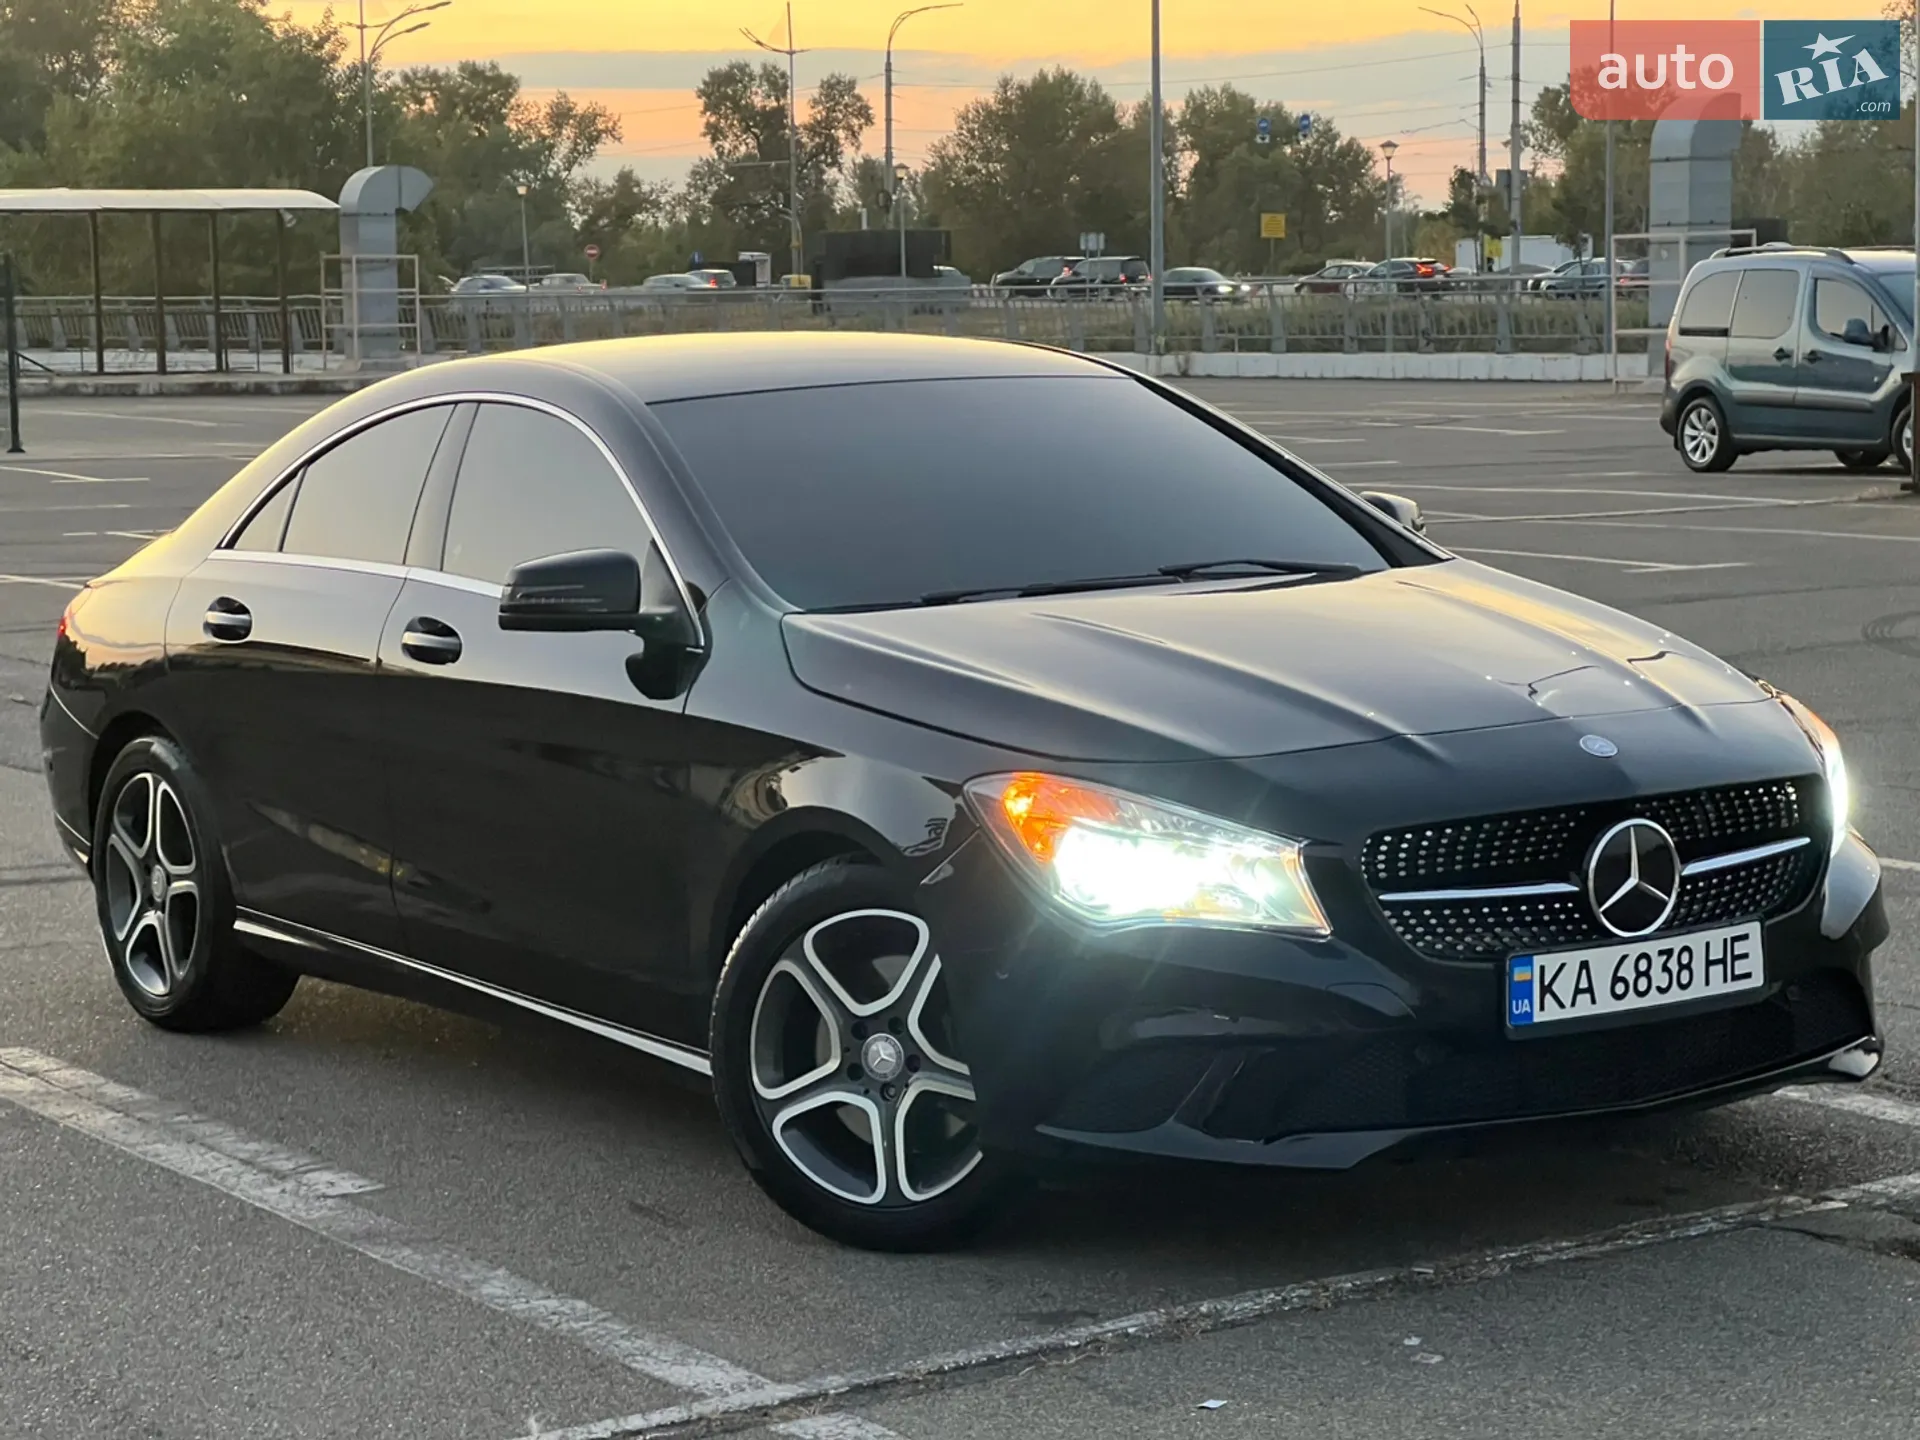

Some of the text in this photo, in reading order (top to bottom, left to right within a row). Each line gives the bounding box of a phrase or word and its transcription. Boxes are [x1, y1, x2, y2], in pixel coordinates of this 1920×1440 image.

[1538, 933, 1752, 1012] KA 6838 HE
[1512, 998, 1531, 1014] UA
